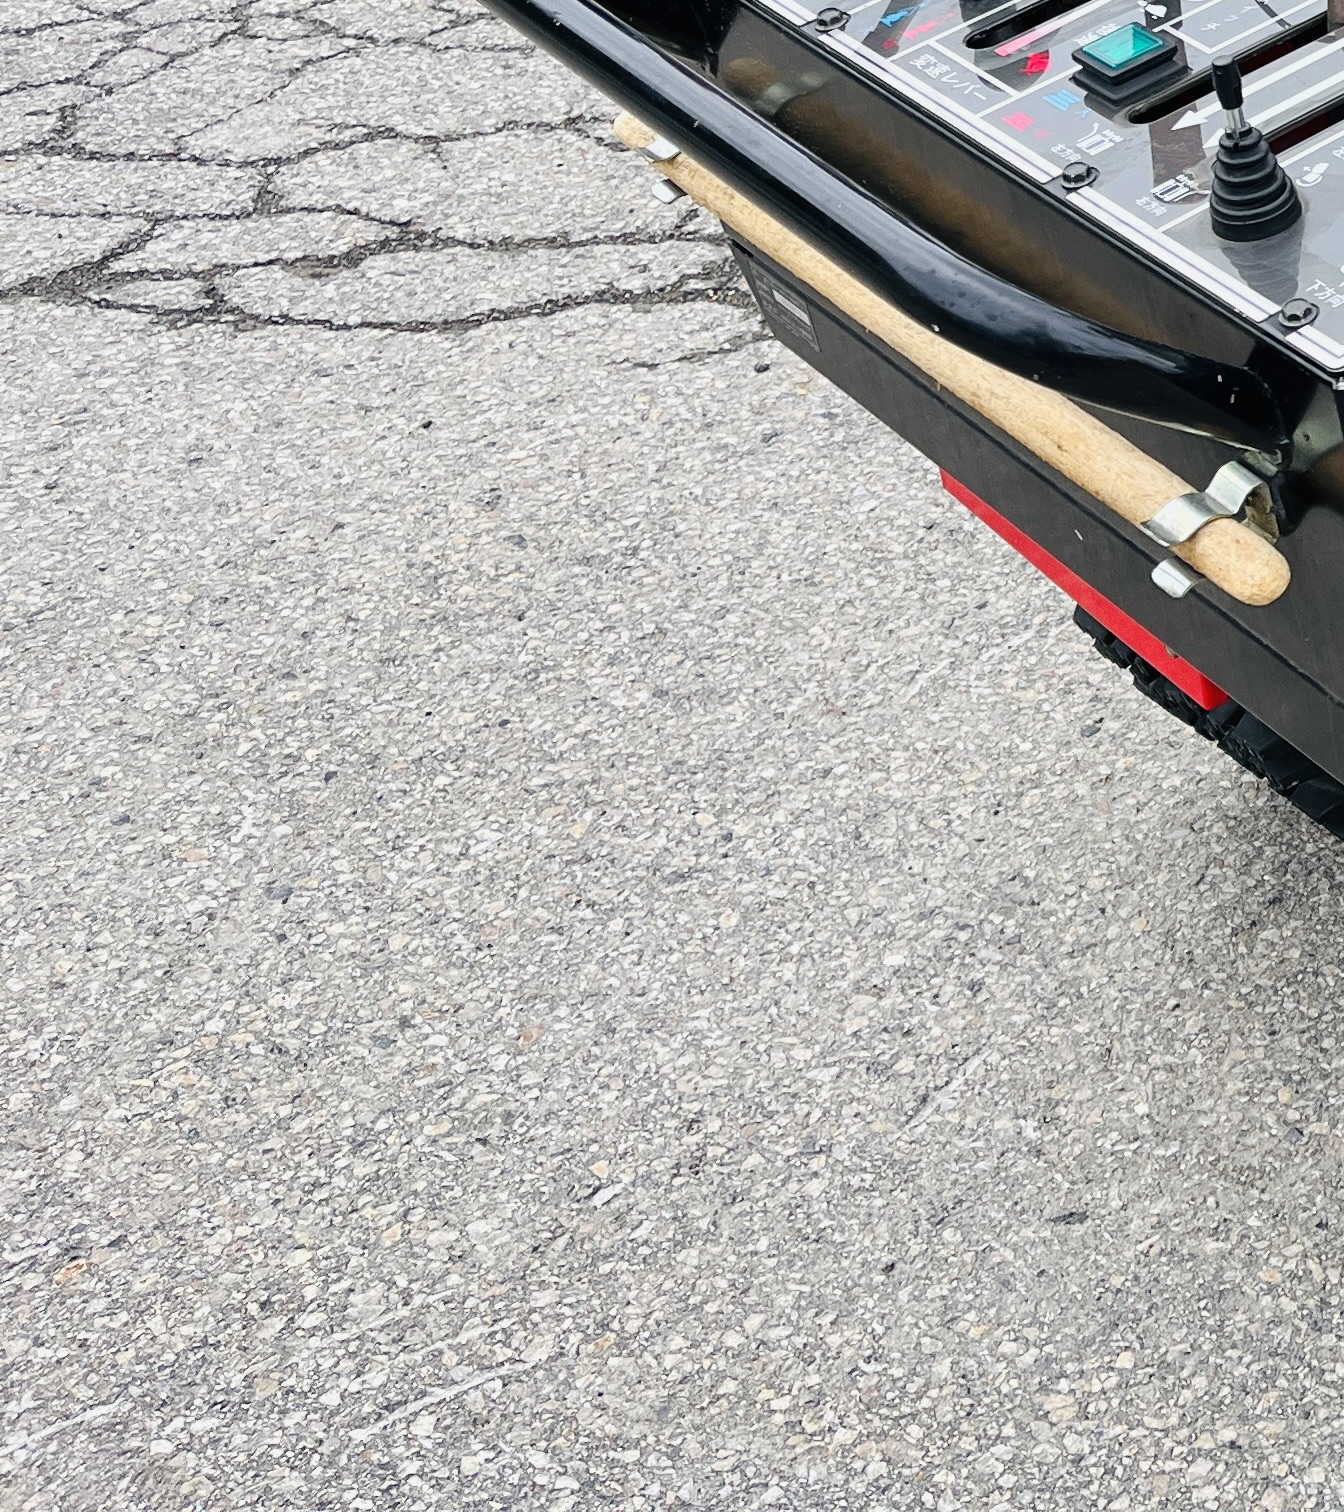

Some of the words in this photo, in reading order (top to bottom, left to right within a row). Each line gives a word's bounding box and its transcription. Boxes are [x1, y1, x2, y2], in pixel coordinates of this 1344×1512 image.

[908, 53, 988, 102] 変速レバー
